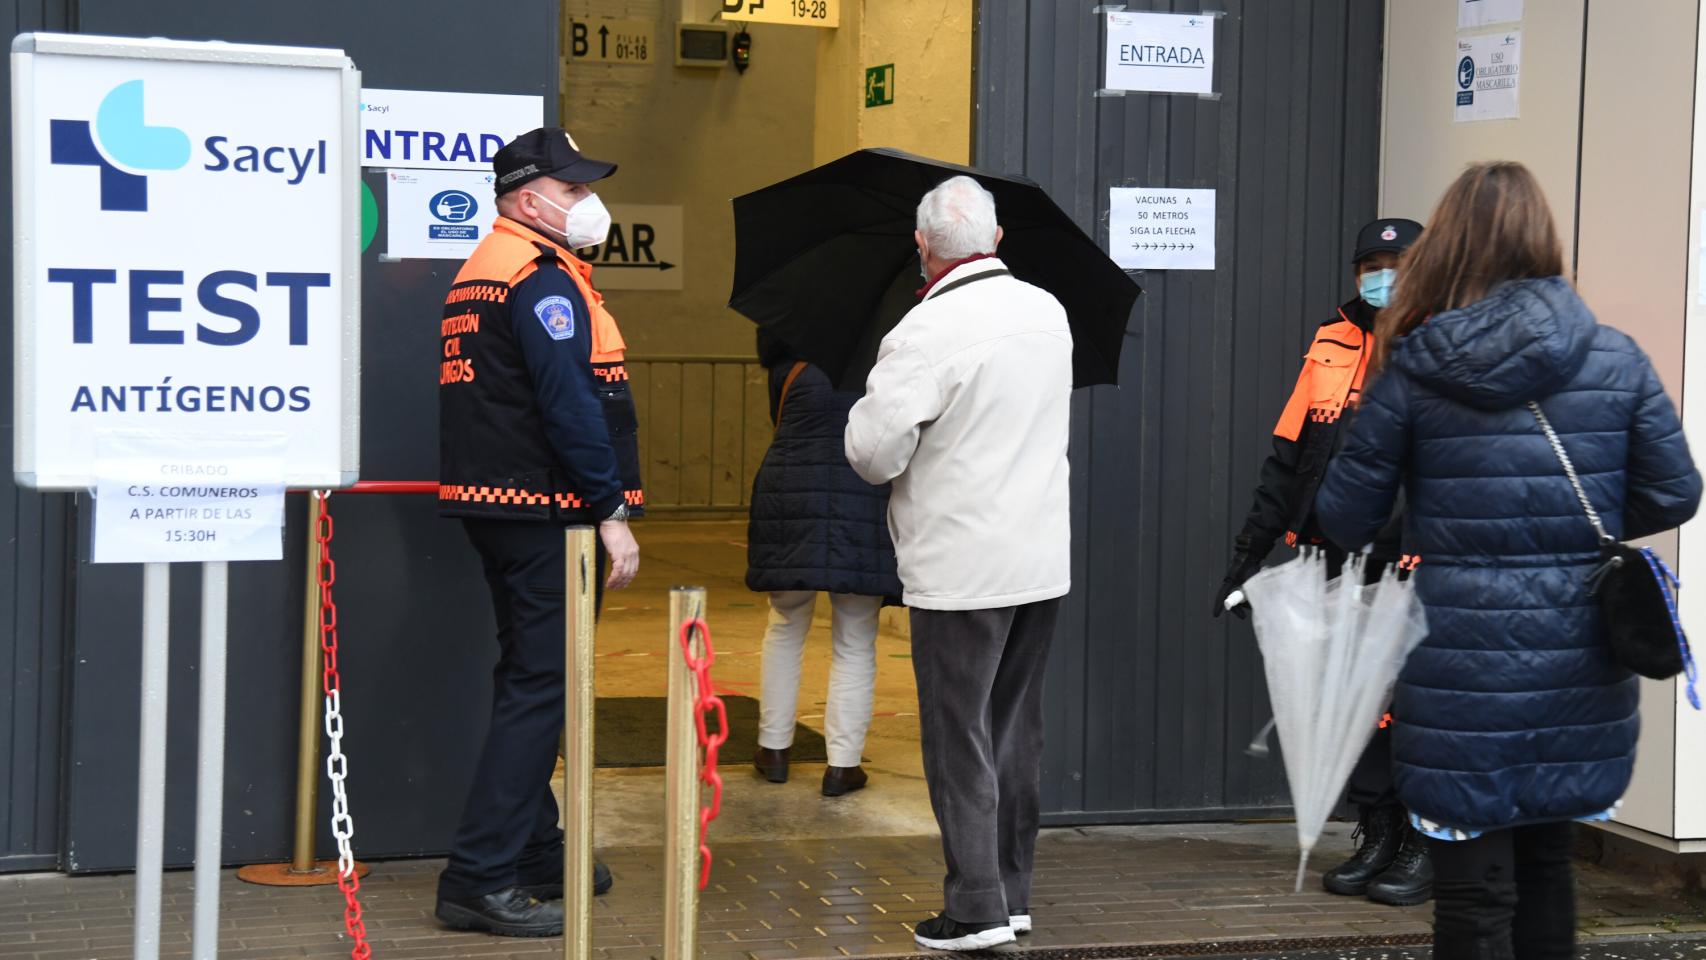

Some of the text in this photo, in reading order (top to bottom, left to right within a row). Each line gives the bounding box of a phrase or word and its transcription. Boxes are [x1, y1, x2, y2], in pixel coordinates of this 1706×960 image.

[791, 0, 827, 19] 19-28
[572, 23, 589, 57] B
[616, 34, 647, 44] FILAS
[616, 43, 647, 60] 01-18
[1120, 44, 1205, 65] ENTRADA
[1476, 64, 1519, 76] OBLIGATORIO
[1476, 78, 1516, 89] MASCARILLA
[367, 104, 389, 113] Sacyl
[366, 129, 505, 163] NTRAD
[204, 136, 327, 184] Sacyl
[1135, 196, 1177, 204] VACUNAS
[1138, 211, 1189, 220] 50 METROS
[1130, 226, 1196, 235] SIGA LA FLECHA
[47, 267, 331, 346] TEST
[440, 358, 475, 384] URGOS
[71, 376, 312, 413] ANTÍGENOS
[160, 464, 229, 476] CRIBADO
[128, 485, 259, 498] C.S. COMUNEROS
[130, 508, 252, 520] A PARTIR DE LAS
[165, 530, 216, 543] 15:30H
